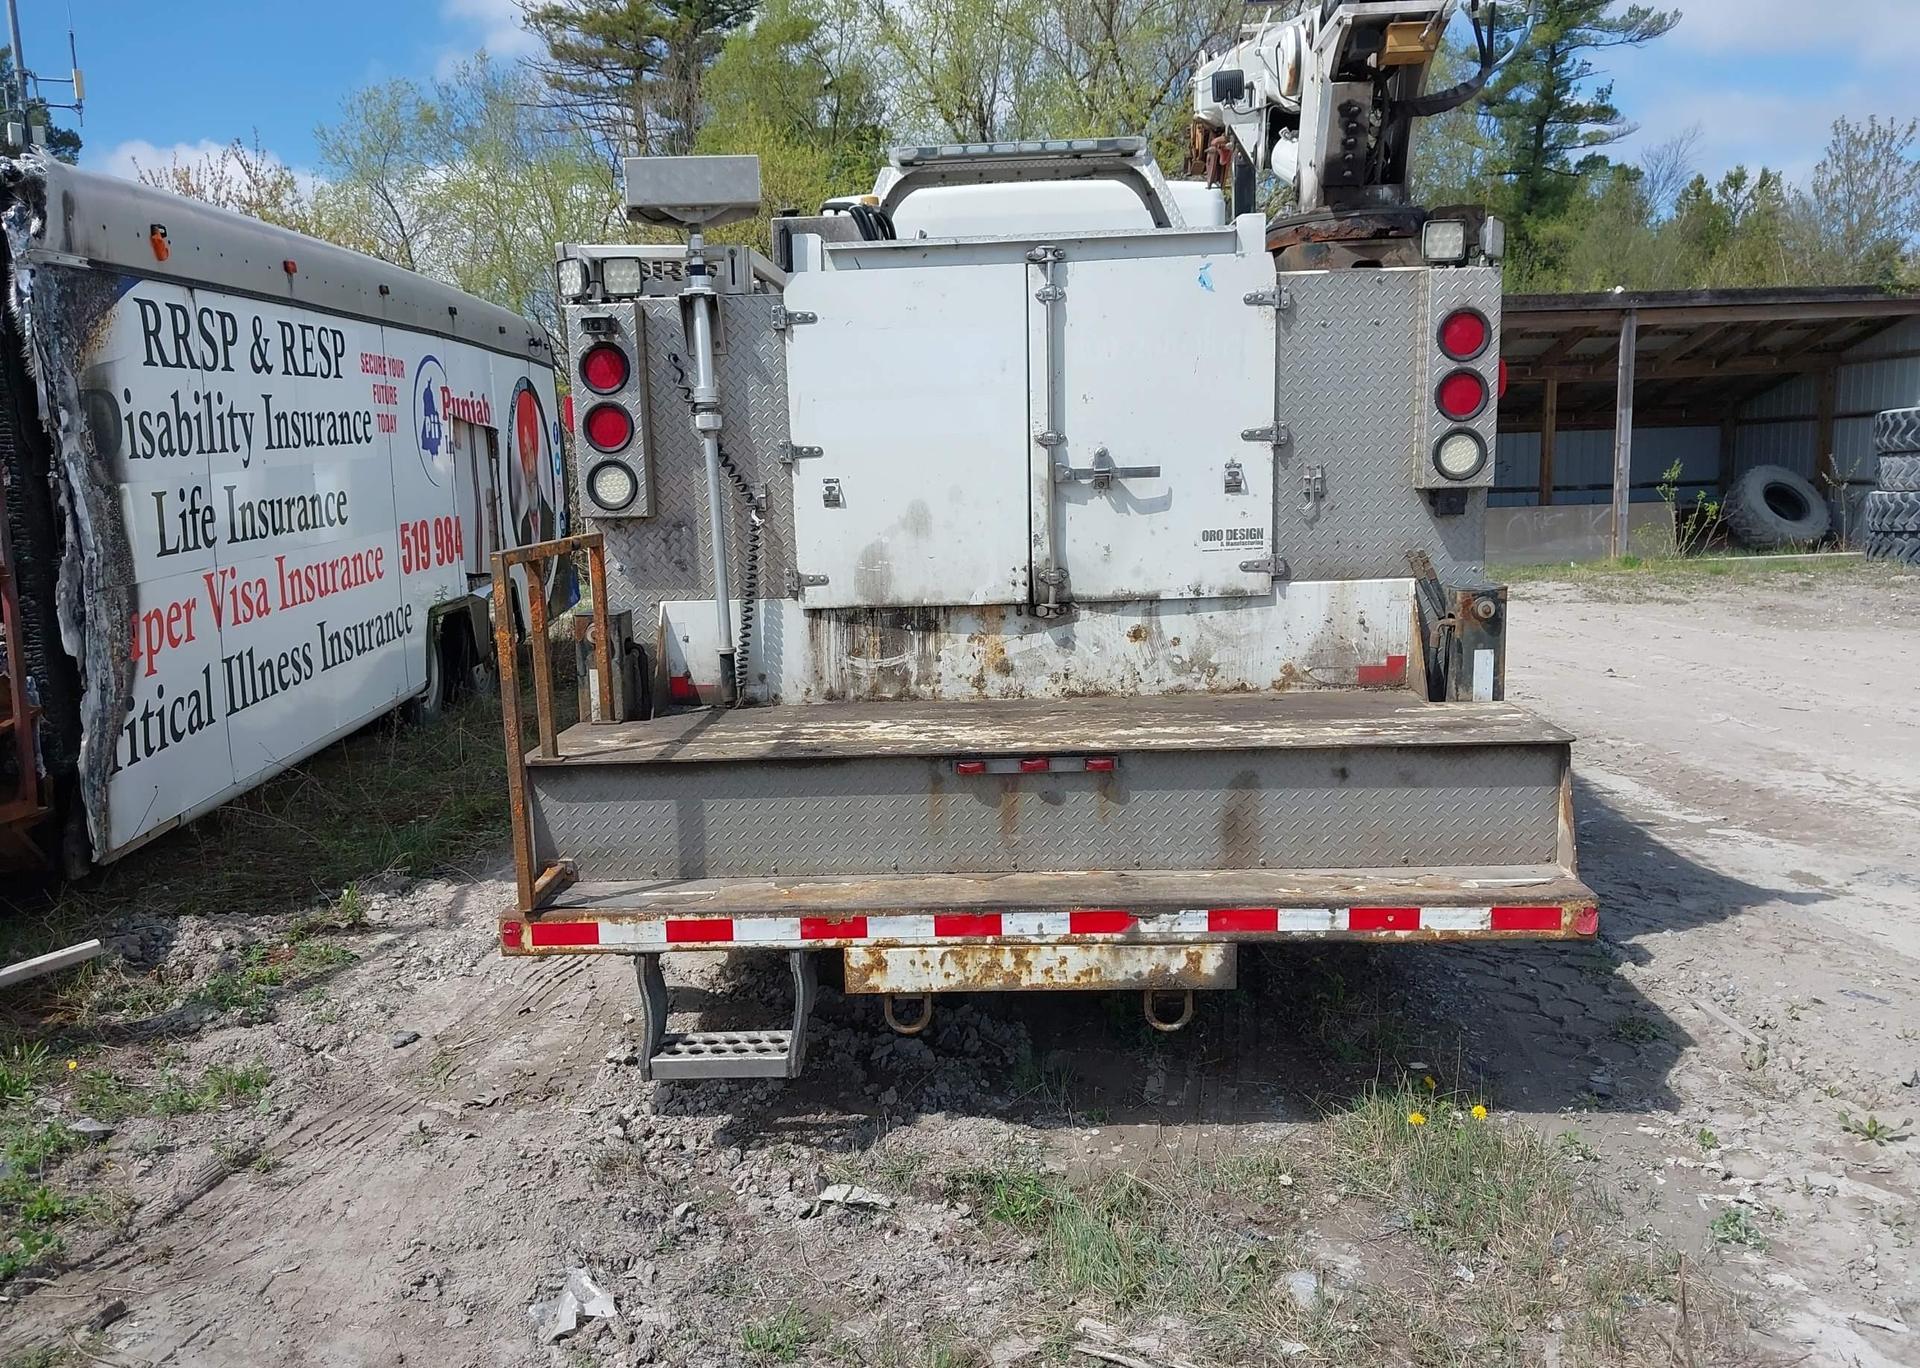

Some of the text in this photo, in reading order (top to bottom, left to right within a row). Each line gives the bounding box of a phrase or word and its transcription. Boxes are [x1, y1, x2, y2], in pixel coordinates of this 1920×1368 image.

[133, 297, 345, 379] RRSP & RESP
[360, 352, 405, 379] SECURE YOUR
[261, 393, 373, 450] Insurance
[372, 384, 397, 405] FUTURE
[376, 413, 397, 433] TODAY
[440, 386, 491, 425] Punjab
[151, 485, 348, 558] Life Insurance
[400, 516, 463, 575] 519 984
[1201, 527, 1264, 542] ORO DESIGN
[203, 566, 271, 632] Visa
[274, 547, 385, 611] Insurance
[222, 646, 314, 718] Illness
[317, 603, 413, 672] Insurance
